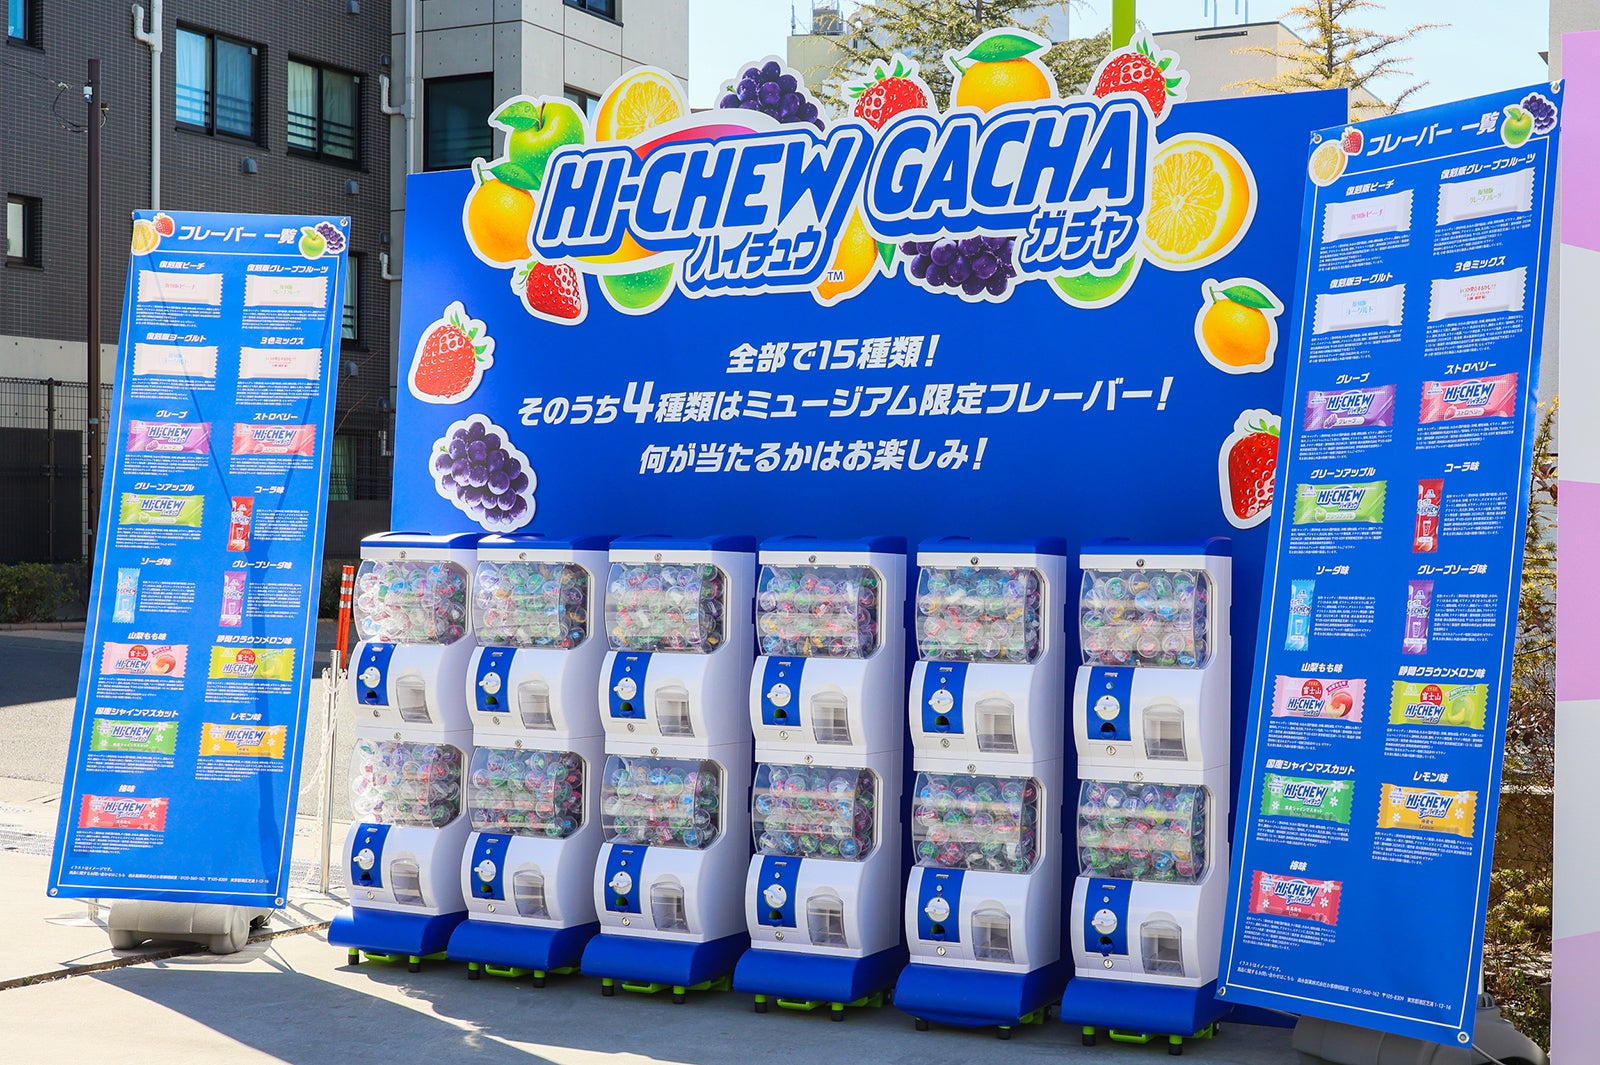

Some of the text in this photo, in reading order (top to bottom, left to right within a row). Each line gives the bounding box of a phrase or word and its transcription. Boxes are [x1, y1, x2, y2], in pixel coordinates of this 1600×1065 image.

[1366, 111, 1500, 157] フレーバー 一覧
[873, 110, 1132, 216] GACHA
[1440, 153, 1537, 180] 復刻版グレープフルーツ
[178, 226, 298, 244] フレーバー 一覧
[1022, 205, 1131, 260] ガチャ
[689, 225, 823, 278] ハイチュウ
[1454, 256, 1506, 273] 3色ミックス
[827, 271, 845, 281] TM
[726, 334, 940, 374] 全部で15種類！
[1444, 361, 1497, 375] ストロベリー
[1336, 372, 1370, 384] グレープ
[518, 376, 1174, 427] そのうち4種類はミュージアム限定フレーバー！
[156, 410, 188, 418] グレープ
[639, 437, 988, 475] 何が当たるかはお楽しみ！
[1310, 467, 1376, 479] グリーンアップル
[1444, 461, 1480, 473] コーラ味
[134, 482, 195, 491] グリーンアップル
[254, 485, 285, 494] コーラ味
[140, 557, 172, 566] ソーダ味
[232, 560, 293, 569] グレープソーダ味
[1316, 565, 1350, 576] ソーダ味
[1417, 564, 1488, 575] グレープソーダ味
[1301, 662, 1343, 673] 山梨もも味
[1398, 666, 1486, 679] 静岡クラウンメロン味
[1303, 686, 1322, 695] 富士山
[1422, 692, 1441, 700] 富士山
[230, 713, 262, 721] レモン味
[1266, 759, 1356, 775] 国産シャインマスカット
[1413, 771, 1449, 783] レモン味
[1289, 859, 1307, 872] 梅味
